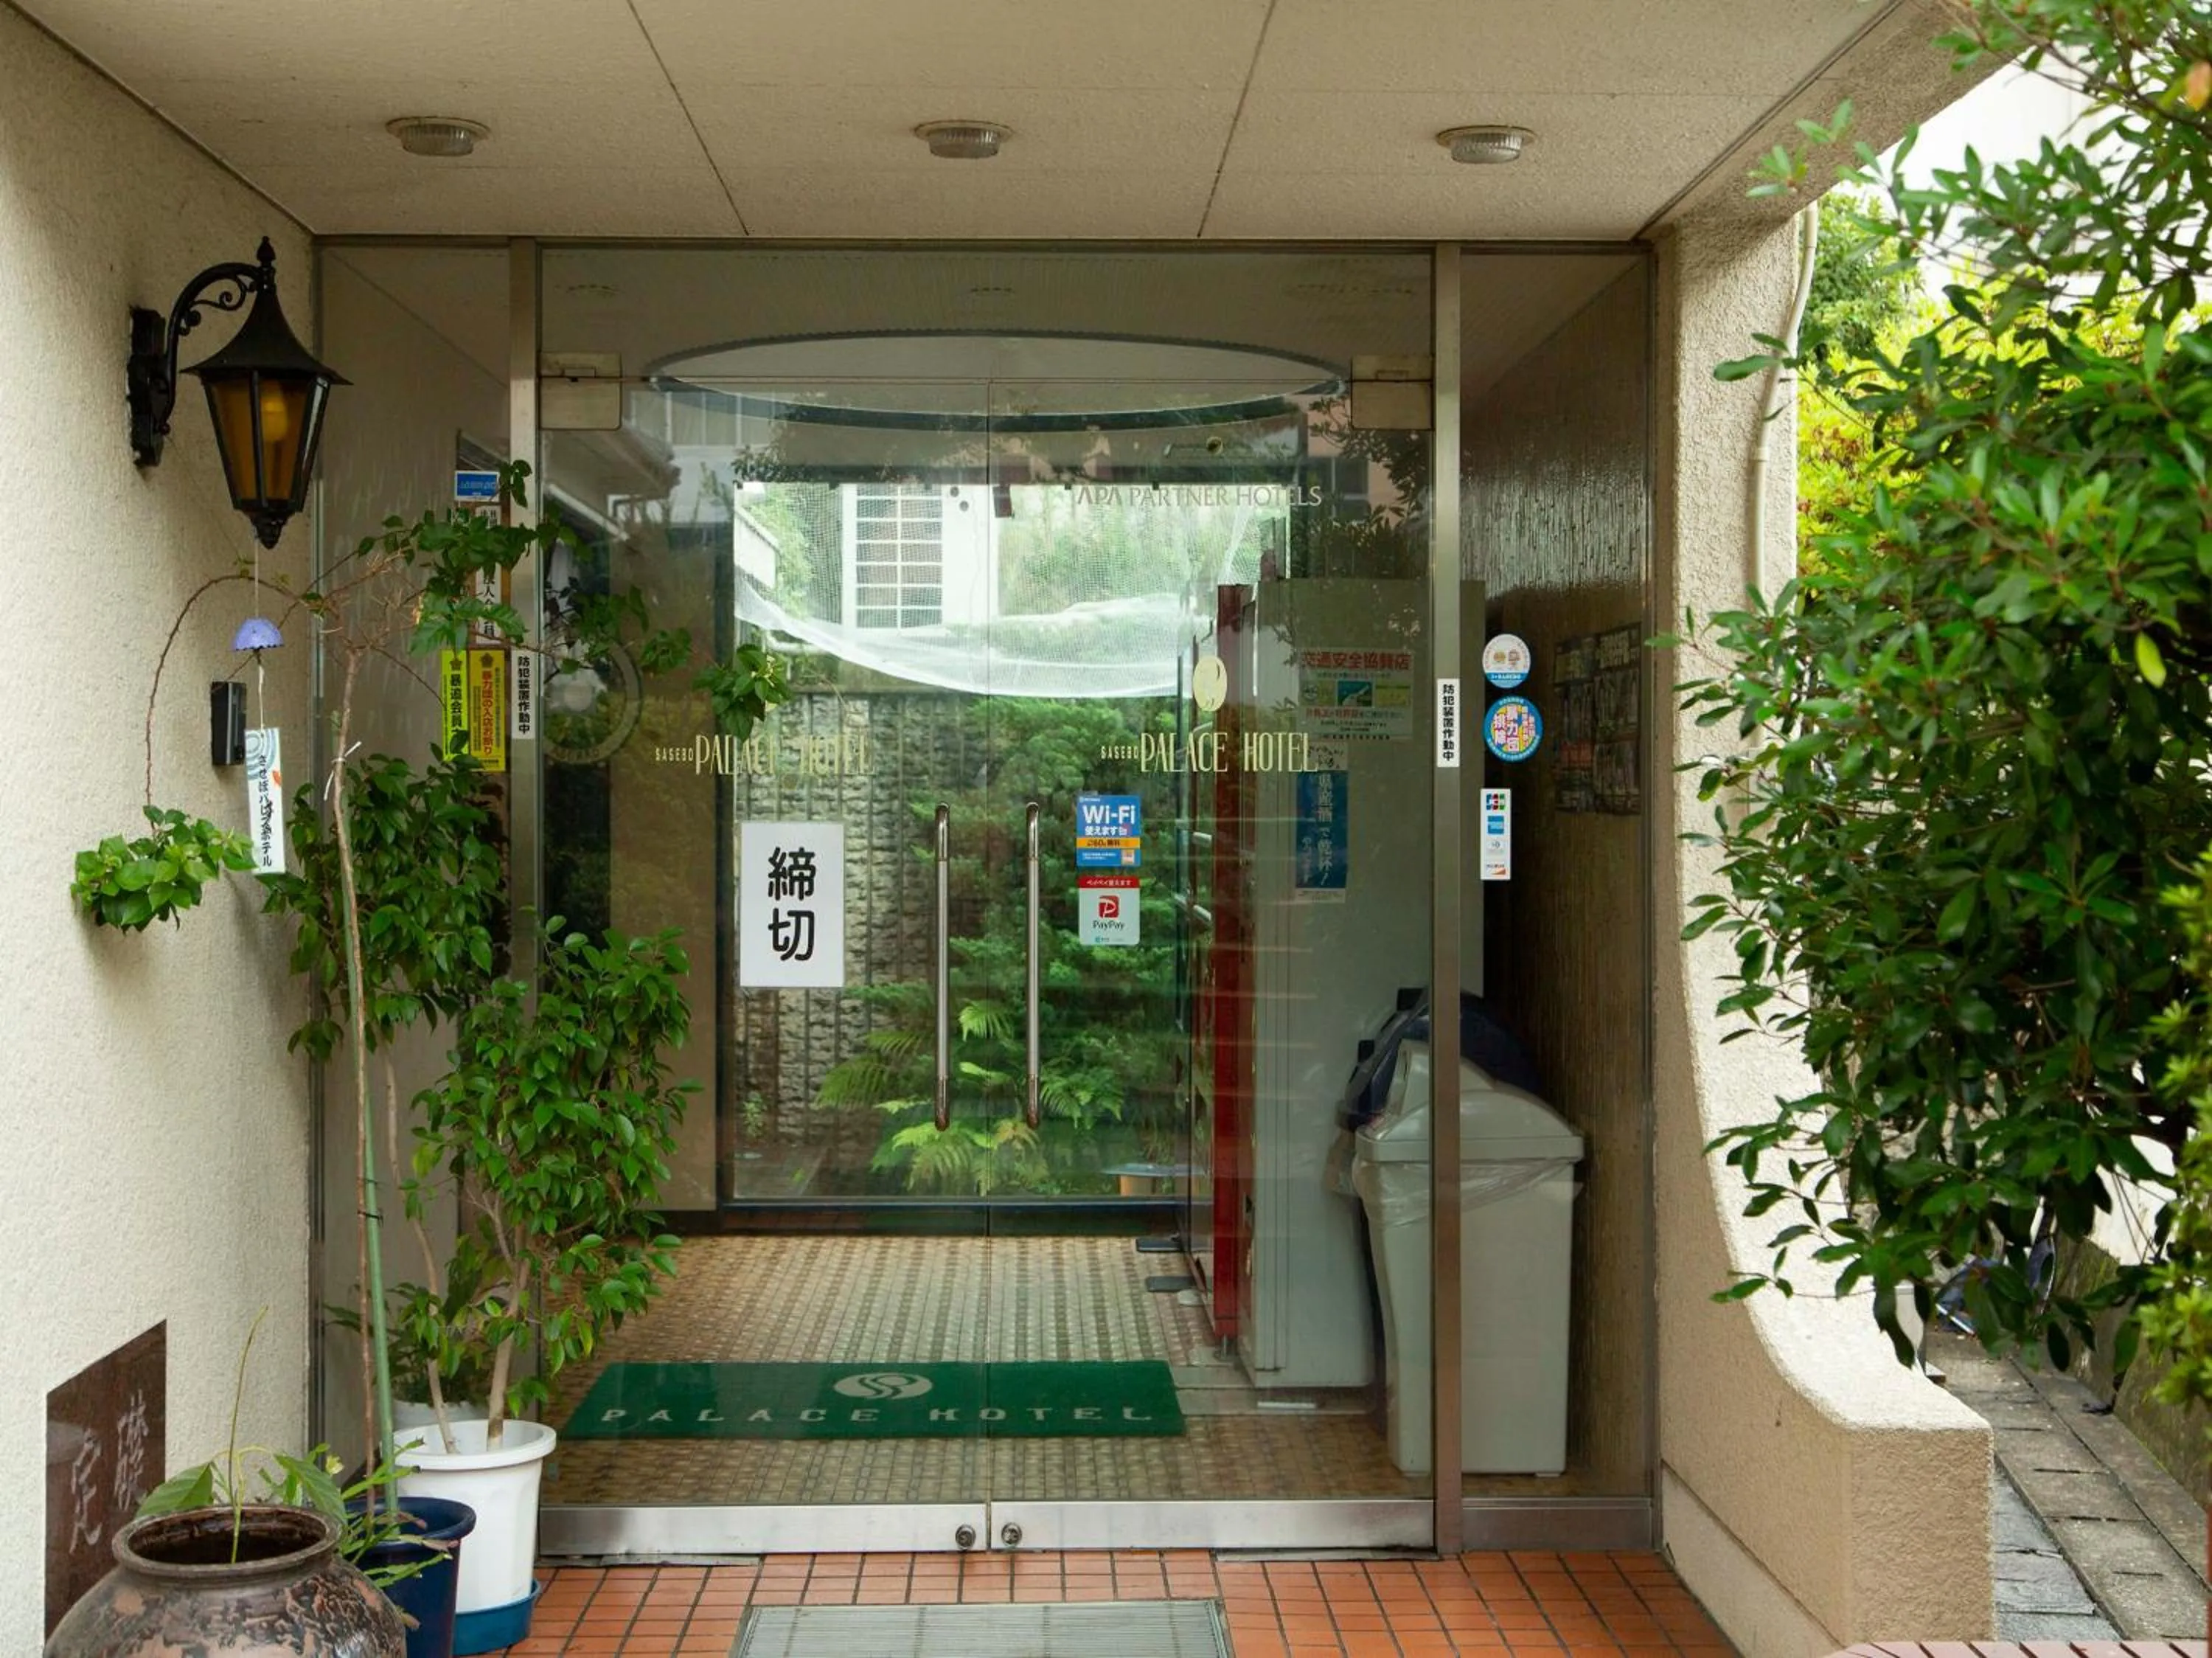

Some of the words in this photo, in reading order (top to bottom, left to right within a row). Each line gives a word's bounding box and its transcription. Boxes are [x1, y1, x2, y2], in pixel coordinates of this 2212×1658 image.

[1077, 485, 1123, 505] APA
[1129, 485, 1230, 506] PARTNER
[1237, 485, 1323, 507] HOTELS
[1442, 684, 1455, 762] 防犯装置作動中
[655, 747, 694, 762] SASEBO
[695, 735, 776, 774] PALACE
[1100, 745, 1138, 760] SASEBO
[1140, 732, 1228, 772] PALACE
[1244, 732, 1318, 772] HOTEL
[1082, 805, 1135, 825] Wi-Fi
[768, 847, 816, 961] 締切
[1092, 920, 1125, 931] PayPay
[599, 1407, 880, 1423] PALACE
[928, 1405, 1153, 1423] HOTEL
